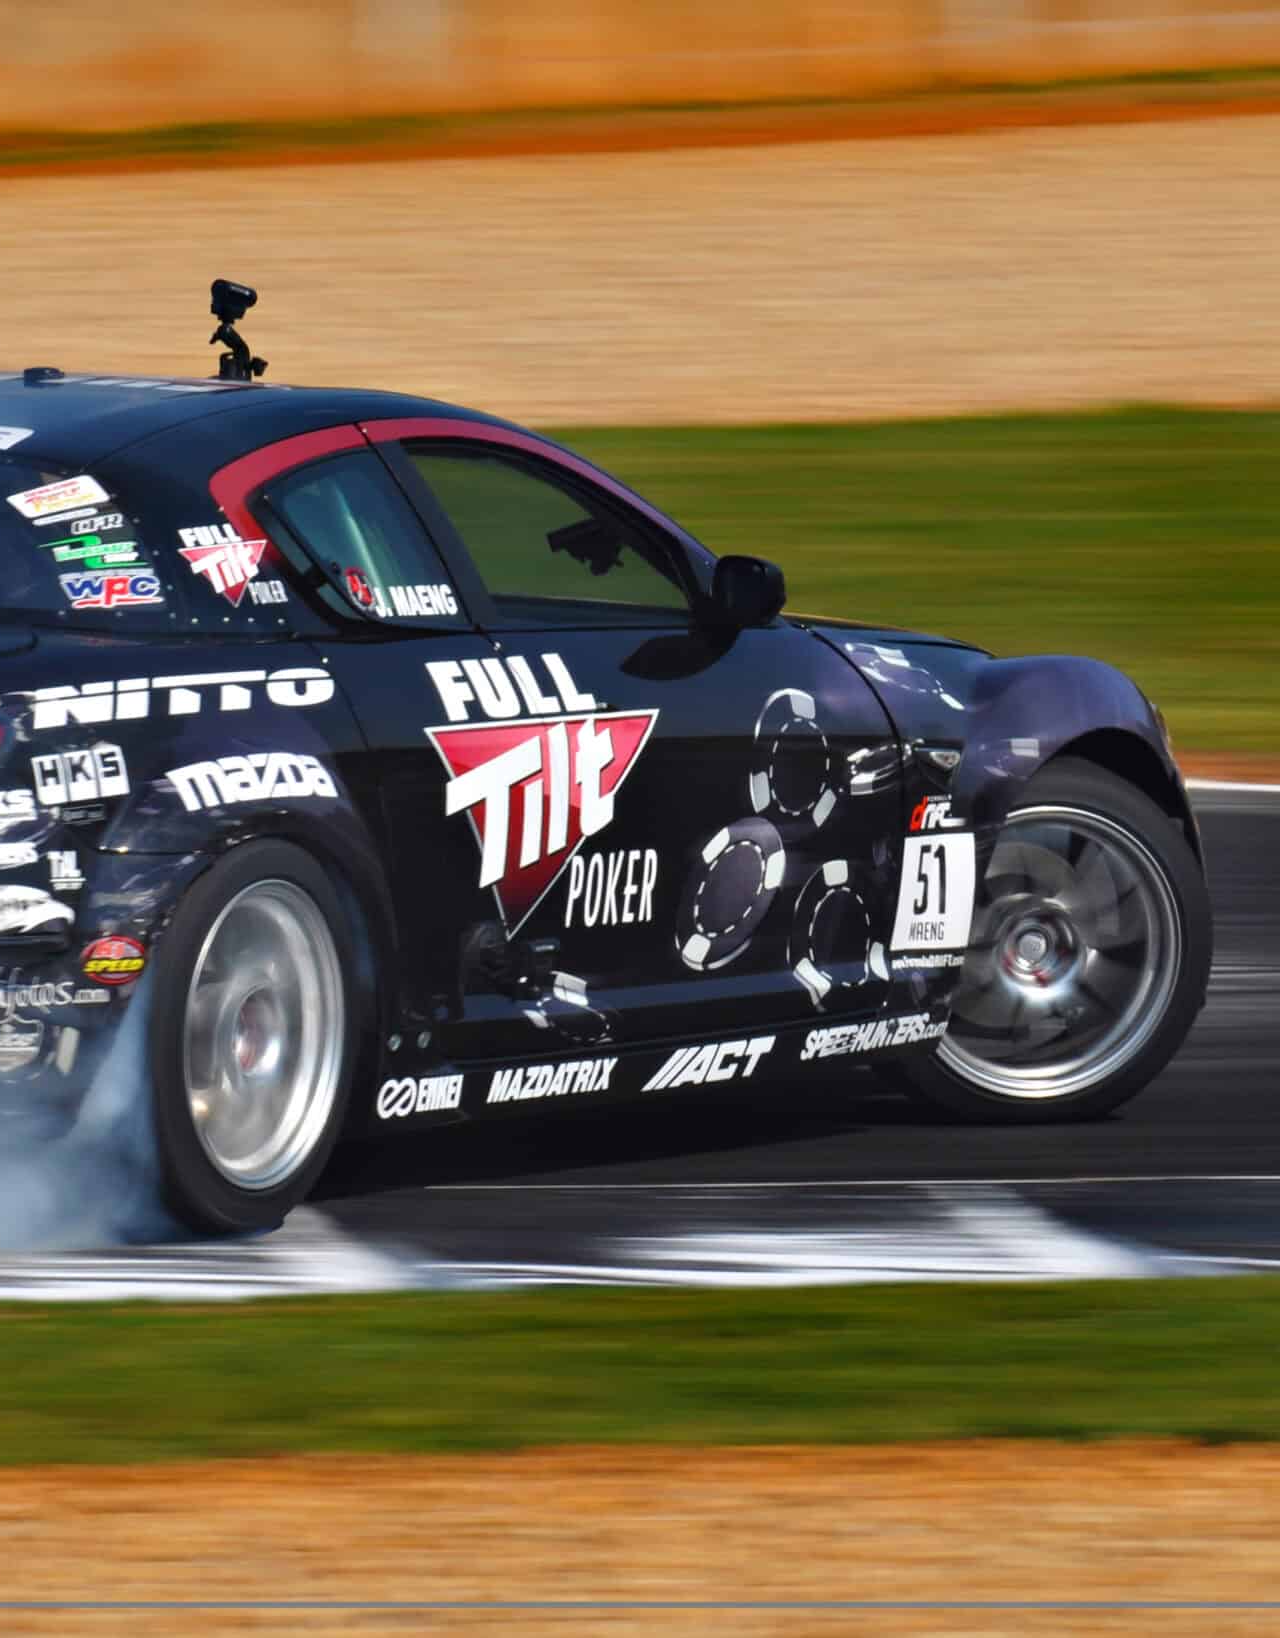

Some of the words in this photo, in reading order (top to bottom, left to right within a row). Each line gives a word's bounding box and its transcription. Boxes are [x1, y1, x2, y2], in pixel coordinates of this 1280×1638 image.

[178, 523, 242, 548] FULL
[391, 584, 459, 617] MAENG
[31, 667, 336, 730] NITTO
[425, 653, 596, 721] FULL
[34, 744, 128, 800] HKS
[445, 717, 615, 889] Tilt
[565, 848, 658, 928] POKER
[913, 844, 948, 915] 51
[909, 922, 945, 941] MAENG
[415, 1074, 464, 1112] ENKEI
[486, 1058, 617, 1104] MAZDATRIX
